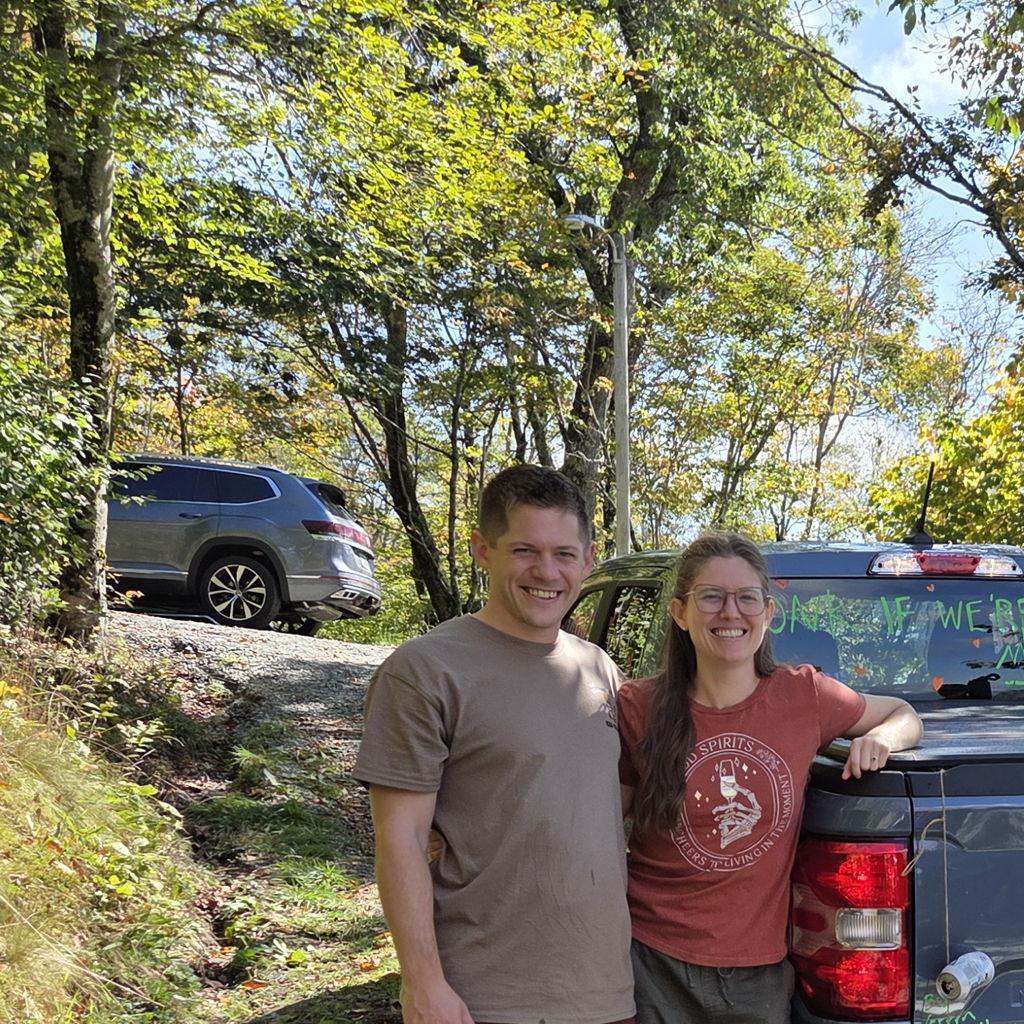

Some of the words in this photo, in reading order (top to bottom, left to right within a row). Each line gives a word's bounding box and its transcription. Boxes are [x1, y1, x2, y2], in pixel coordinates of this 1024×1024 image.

[767, 588, 849, 639] ONK
[880, 596, 915, 635] IF
[698, 736, 755, 756] SPIRITS
[675, 831, 707, 867] HEERS
[763, 837, 775, 852] IN
[778, 773, 793, 818] MOMENT
